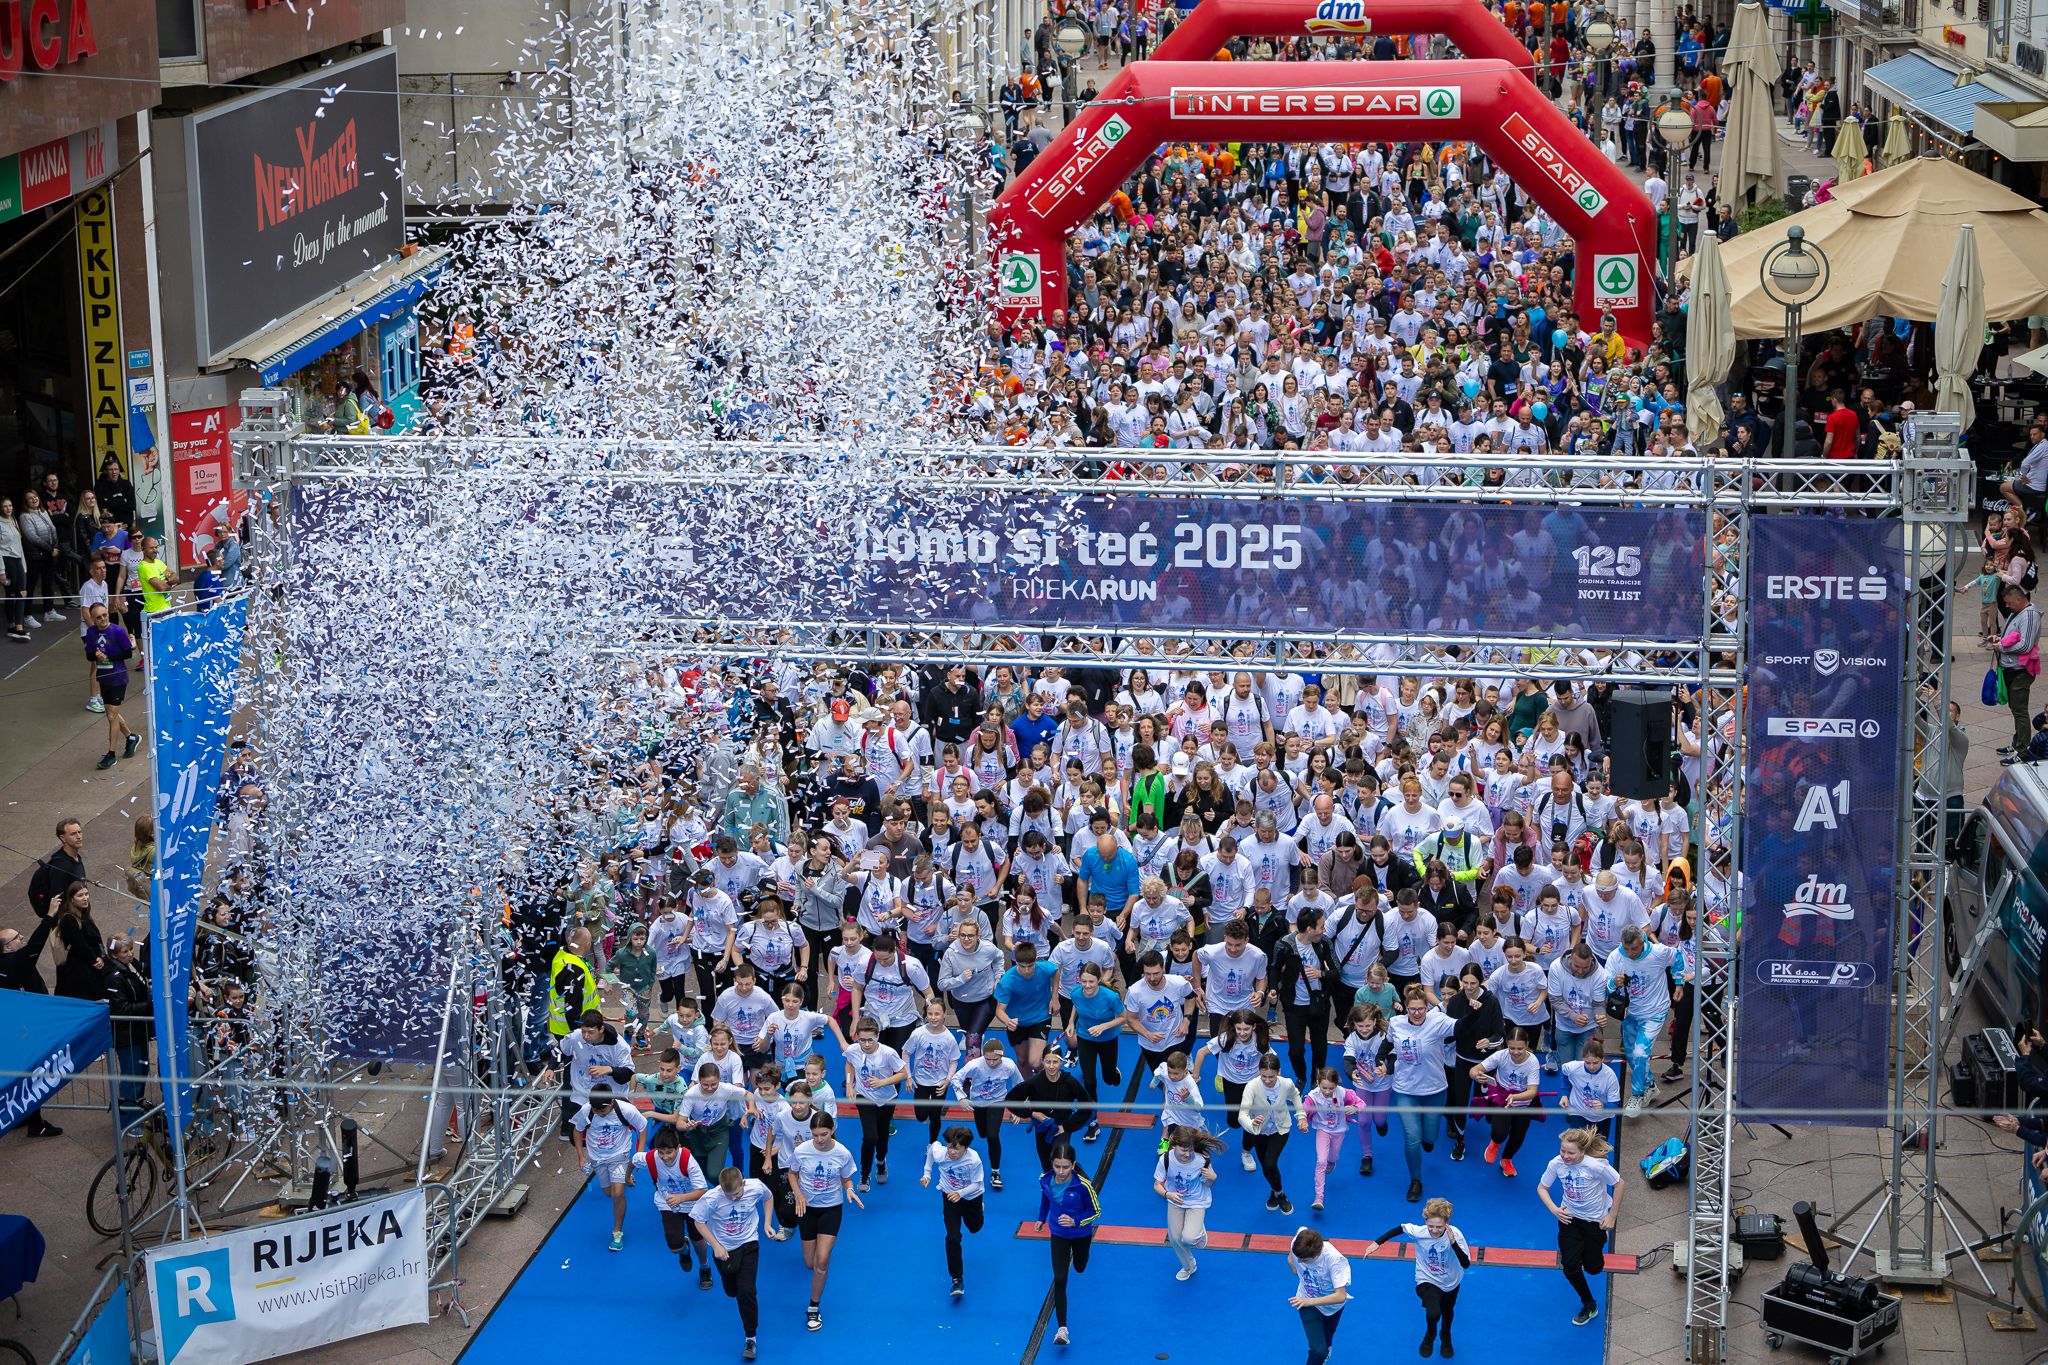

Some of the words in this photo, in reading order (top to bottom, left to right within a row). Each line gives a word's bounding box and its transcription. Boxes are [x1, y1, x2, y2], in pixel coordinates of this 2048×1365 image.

[1319, 0, 1361, 19] dm
[1198, 95, 1418, 113] INTERSPAR
[25, 144, 67, 189] MANA
[1048, 139, 1106, 198] SPAR
[1521, 133, 1581, 192] SPAR
[293, 232, 320, 268] Dress
[319, 220, 335, 265] for
[337, 214, 351, 246] the
[81, 193, 111, 327] OTKUP
[1002, 296, 1040, 305] SPAR
[1597, 298, 1637, 306] SPAR
[94, 341, 125, 473] ZLATA
[203, 411, 221, 434] A1
[173, 441, 189, 449] Buy
[190, 438, 208, 448] your
[194, 470, 206, 479] 10
[1013, 521, 1060, 565] si
[1074, 522, 1158, 567] teć
[1174, 522, 1302, 570] 2025
[1571, 545, 1642, 577] 125
[1013, 578, 1157, 602] RIJEKARUN
[1578, 590, 1610, 600] NOVI
[1613, 591, 1642, 601] LIST
[1767, 575, 1854, 600] ERSTE
[1765, 656, 1811, 665] SPORT
[1841, 657, 1887, 667] VISION
[1785, 720, 1854, 734] SPAR
[1793, 780, 1850, 832] A1
[1795, 874, 1847, 904] dm
[1771, 963, 1792, 975] PK
[1796, 968, 1819, 976] d.o.o.
[253, 1209, 403, 1273] RIJEKA
[175, 1266, 218, 1318] R
[257, 1259, 421, 1314] www.visitRijeka.hr
